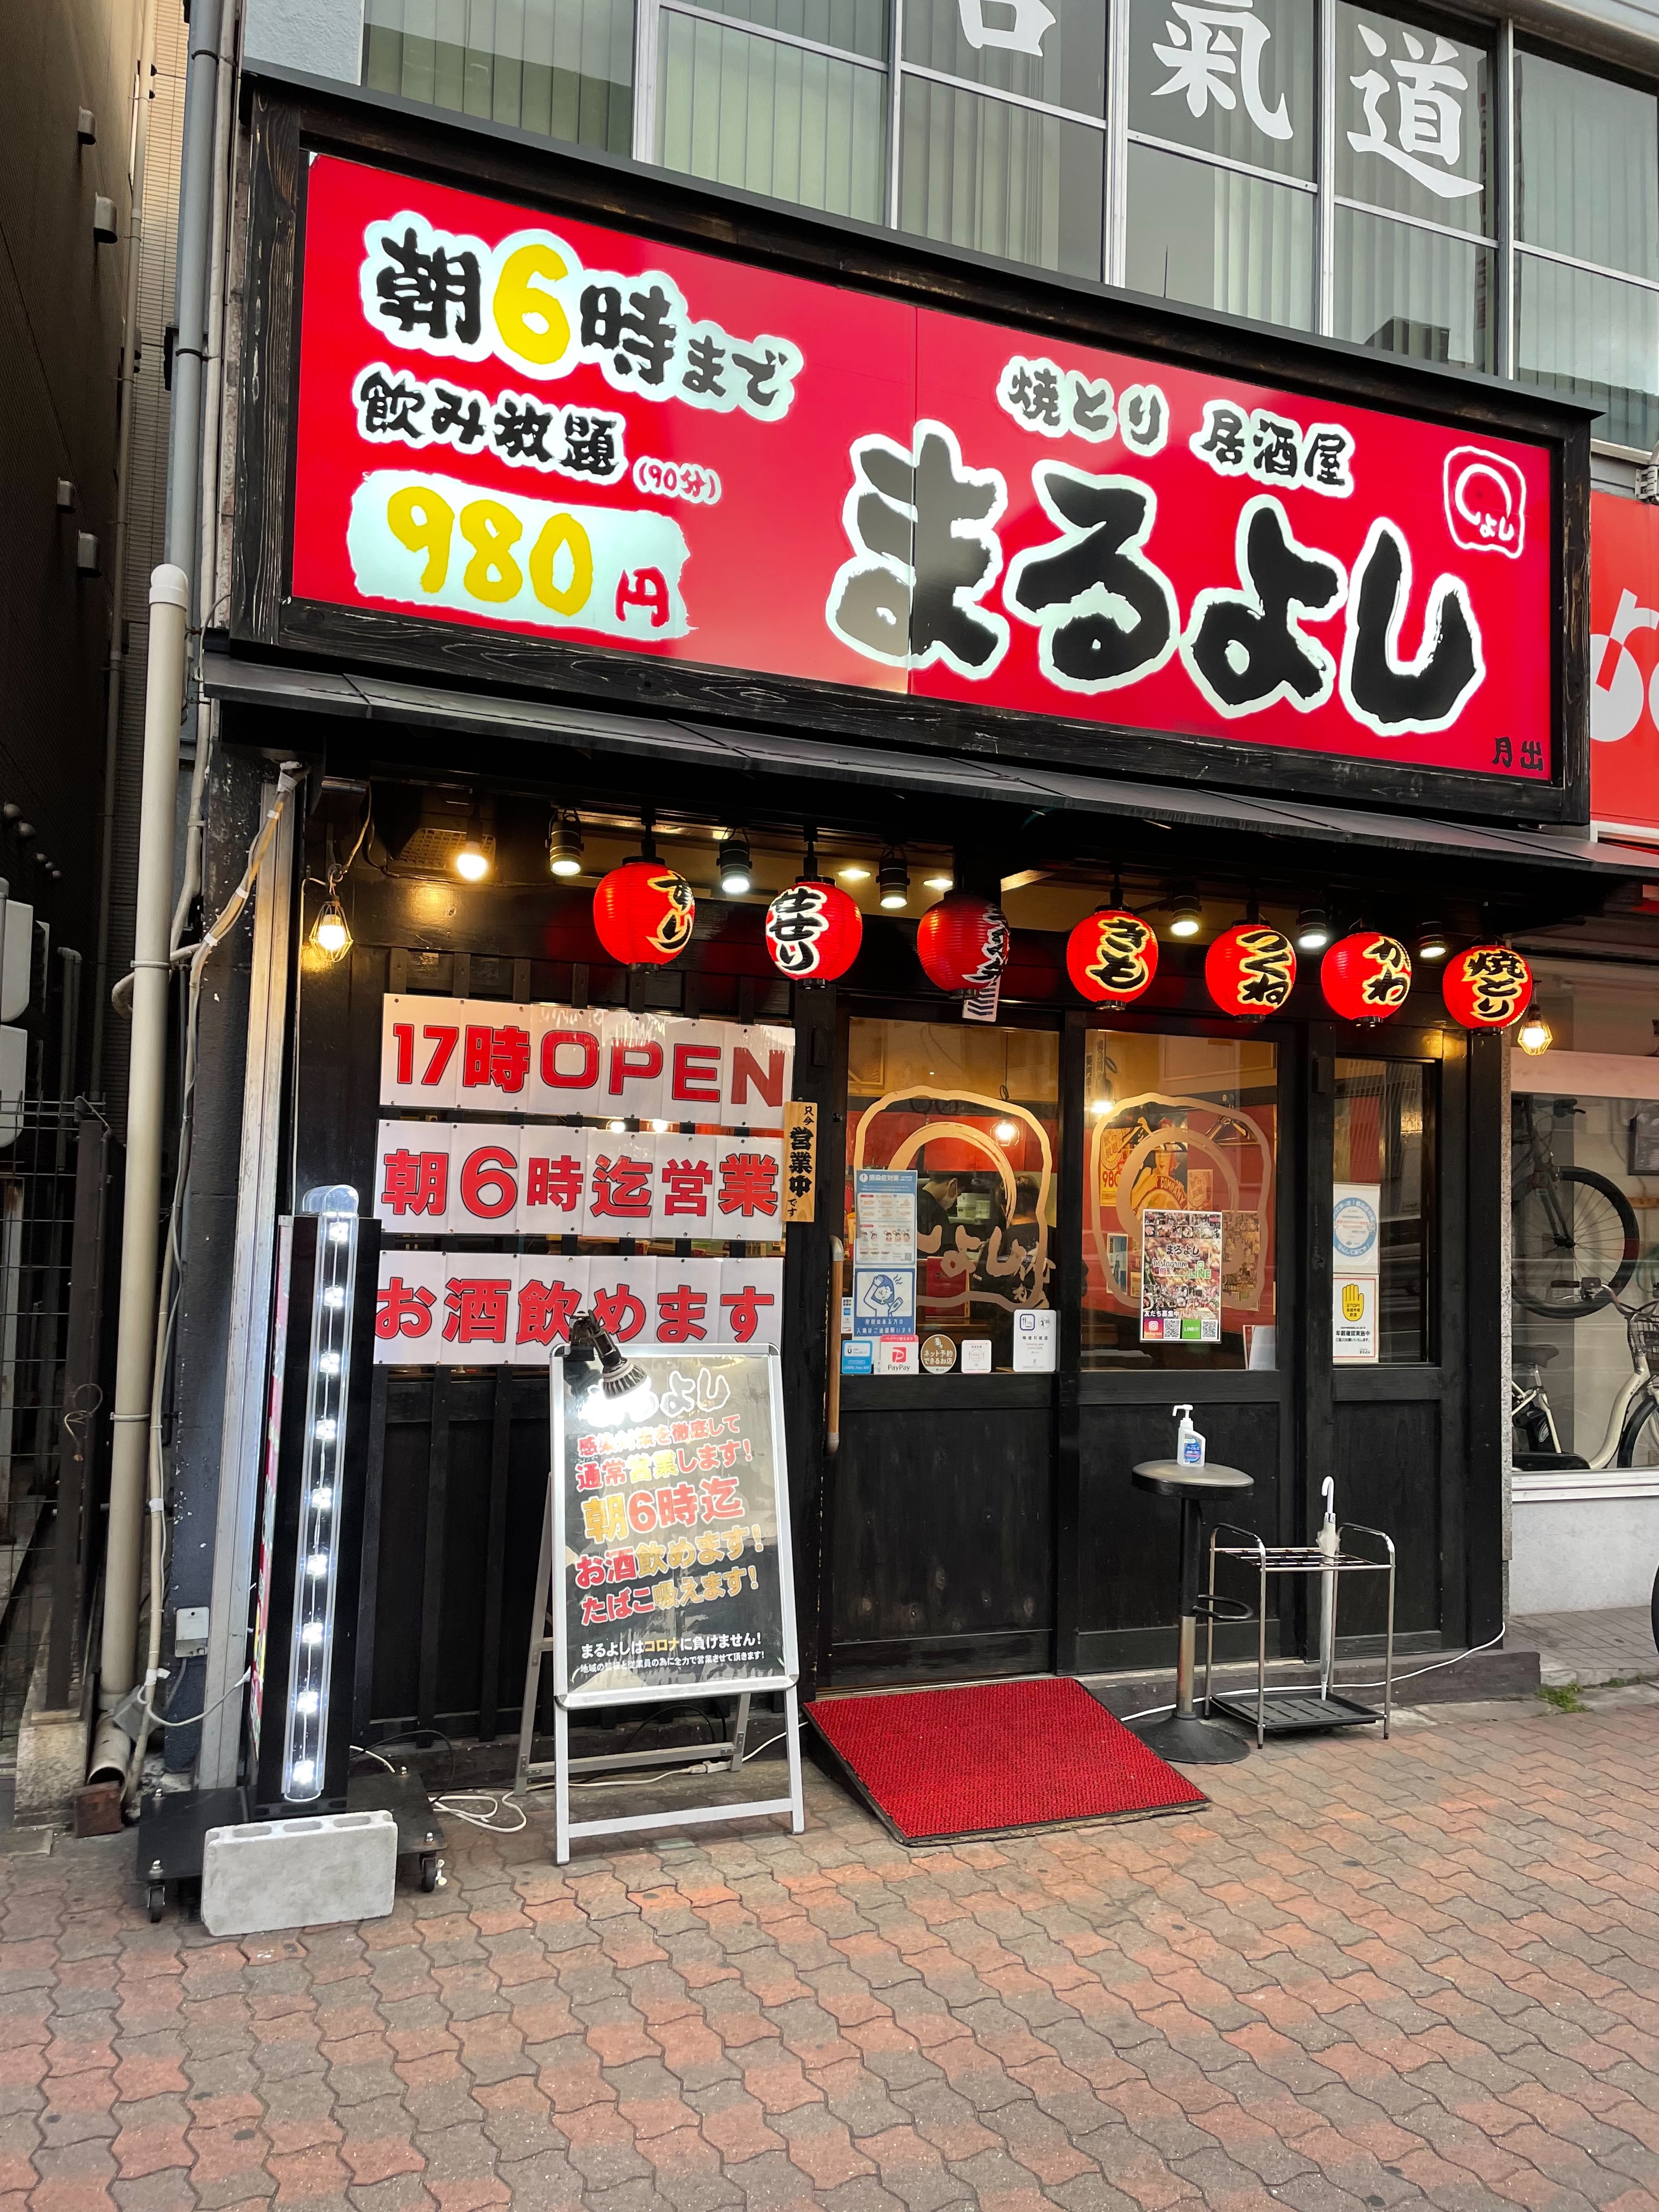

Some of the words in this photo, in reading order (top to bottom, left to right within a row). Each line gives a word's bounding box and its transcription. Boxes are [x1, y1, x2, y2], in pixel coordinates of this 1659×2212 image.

[375, 226, 791, 408] 朝6時まで
[359, 371, 619, 476] 飲み放題
[1008, 358, 1163, 447] 焼とり
[1198, 408, 1347, 488] 居酒屋
[831, 428, 1482, 730] まるよし
[1491, 736, 1544, 771] 月出
[1238, 930, 1293, 1007] つくね
[1364, 936, 1410, 1005] かわ
[1463, 949, 1527, 1021] 焼とり
[393, 1023, 785, 1107] 17時OPEN
[381, 1146, 778, 1218] 朝6時迄営業
[1152, 1258, 1188, 1271] Instagram
[1166, 1244, 1200, 1256] まるよし
[1189, 1268, 1211, 1279] LINE
[375, 1277, 774, 1345] お酒飲めます
[581, 1476, 745, 1544] 朝6時迄
